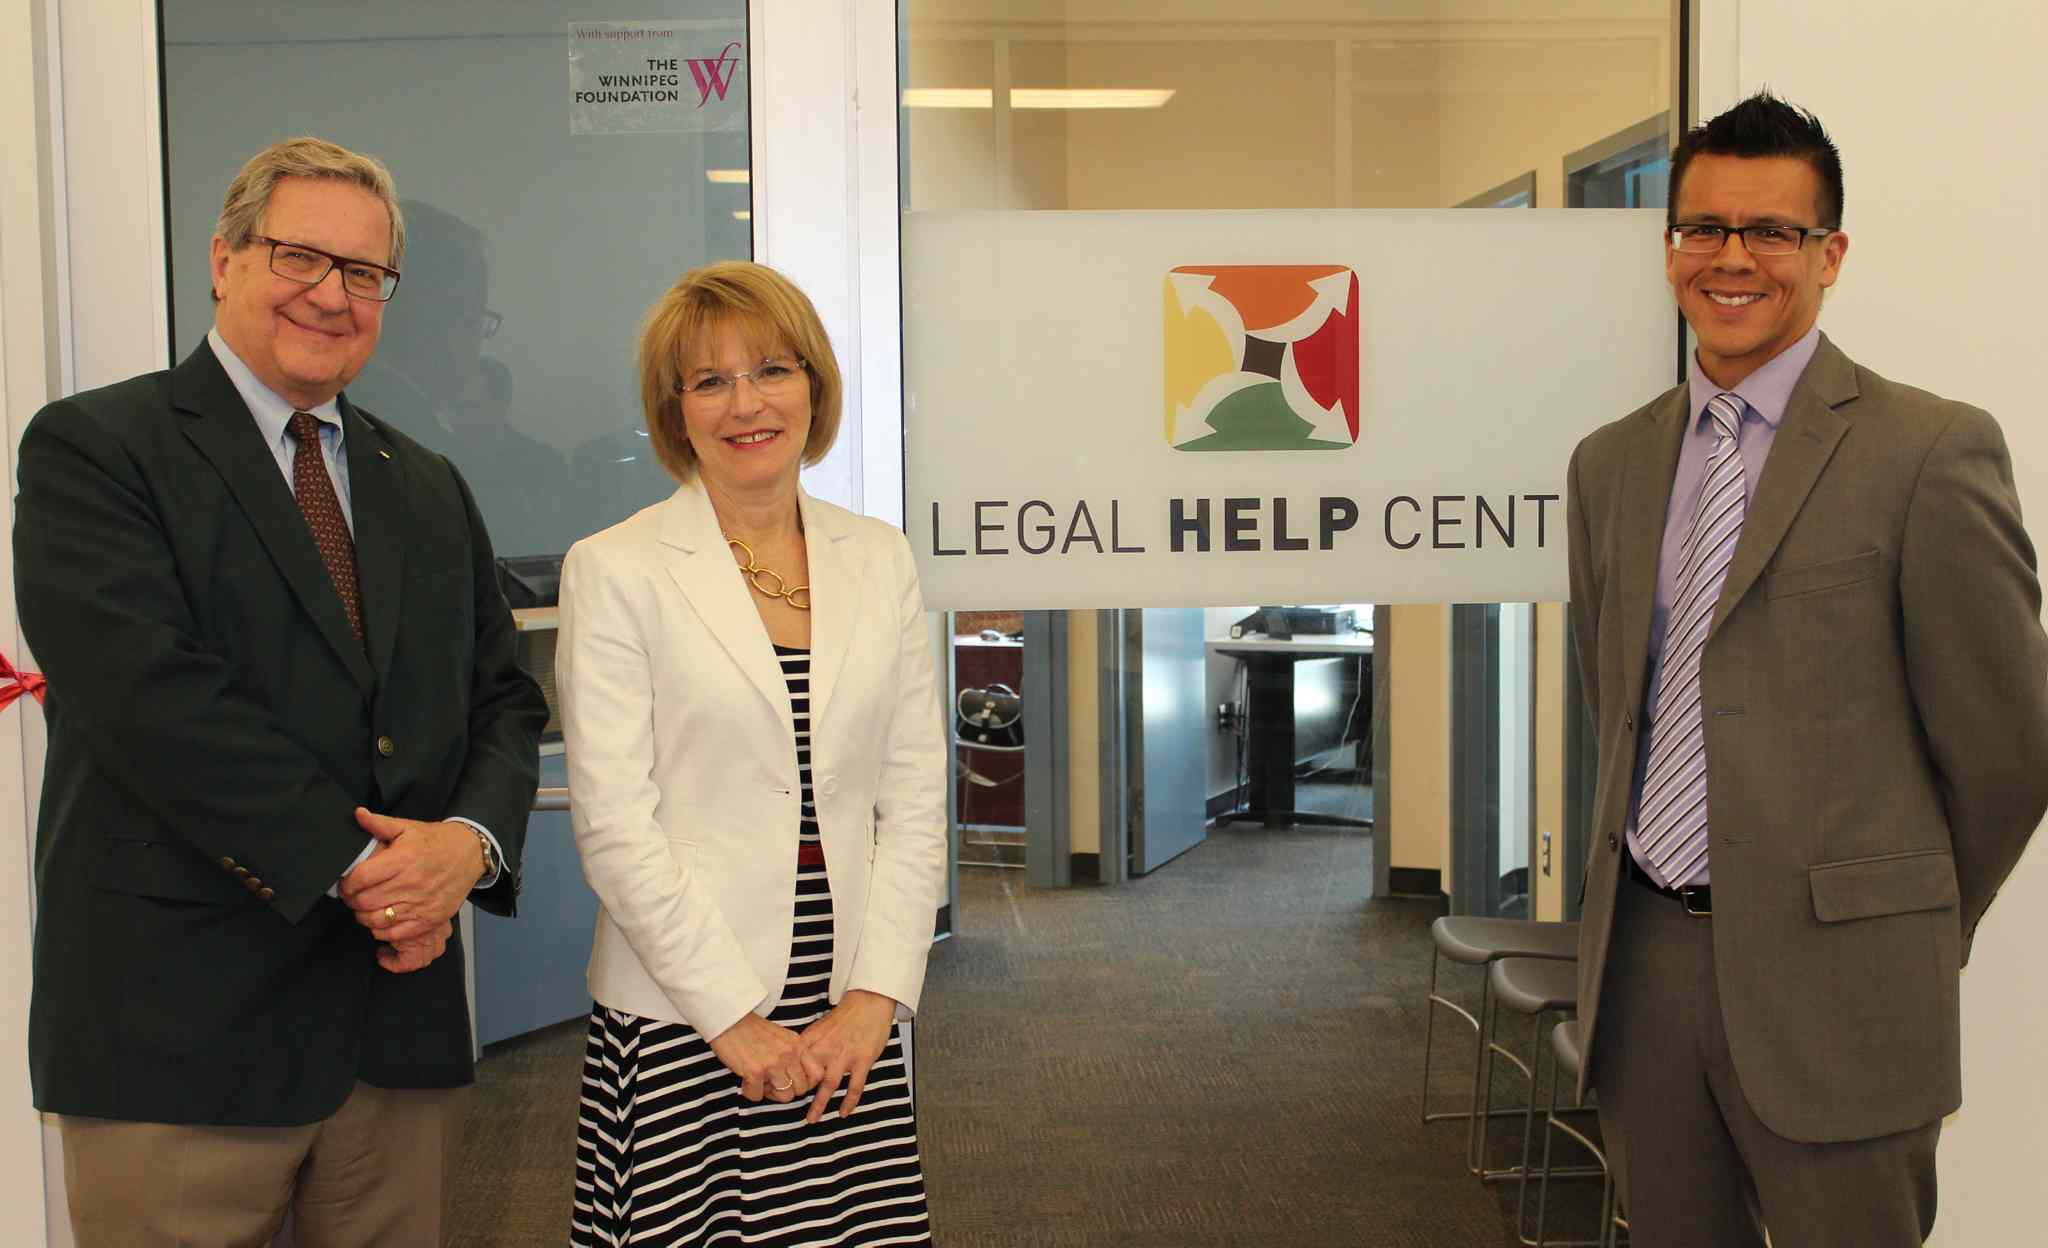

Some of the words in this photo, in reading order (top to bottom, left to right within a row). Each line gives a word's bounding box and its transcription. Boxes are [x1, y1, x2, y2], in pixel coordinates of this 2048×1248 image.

[576, 29, 600, 40] With
[602, 30, 645, 41] support
[647, 28, 673, 38] from
[646, 59, 678, 71] THE
[599, 75, 678, 87] WINNIPEG
[575, 90, 679, 104] FOUNDATION
[932, 499, 1146, 557] LEGAL
[1169, 496, 1359, 553] HELP
